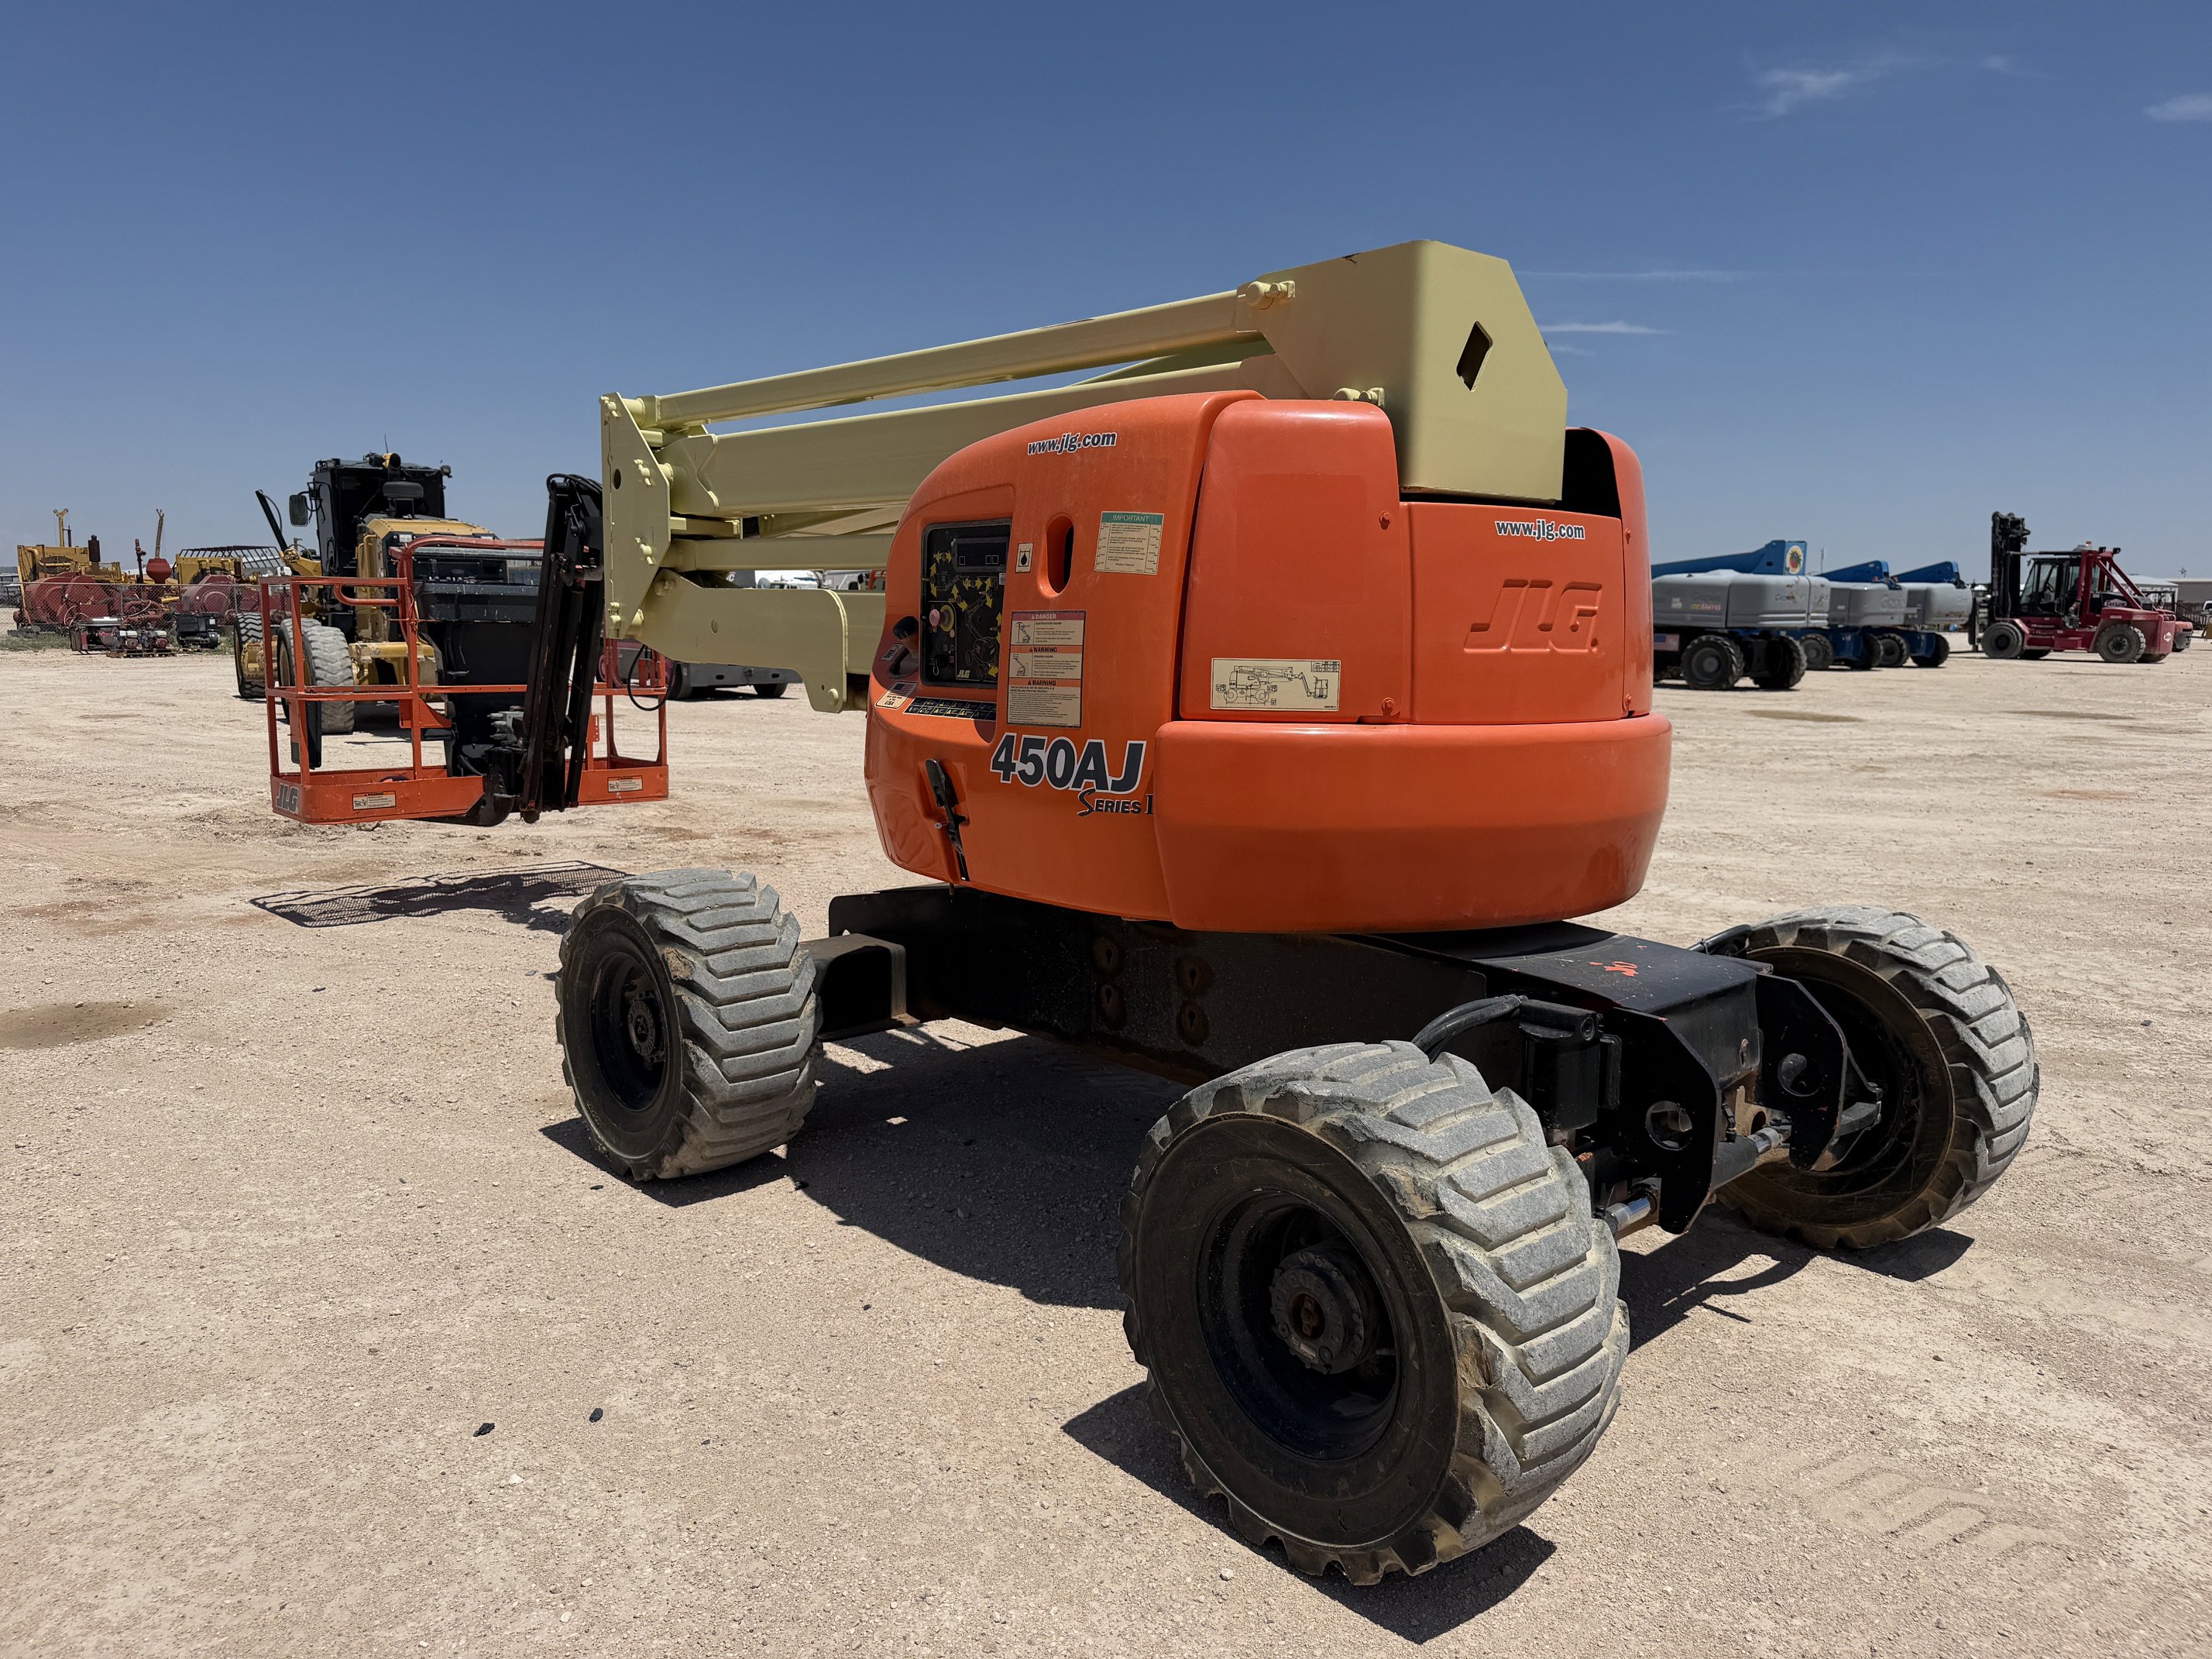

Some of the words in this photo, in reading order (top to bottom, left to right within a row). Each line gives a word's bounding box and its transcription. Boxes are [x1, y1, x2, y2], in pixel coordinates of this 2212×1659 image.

[1029, 432, 1117, 455] www.jlg.com
[1496, 519, 1585, 541] www.jlg.com
[1464, 579, 1602, 653] JLG
[957, 669, 970, 678] JLG
[990, 733, 1146, 794] 450AJ
[276, 782, 300, 813] JLG
[1077, 787, 1142, 817] SERIES
